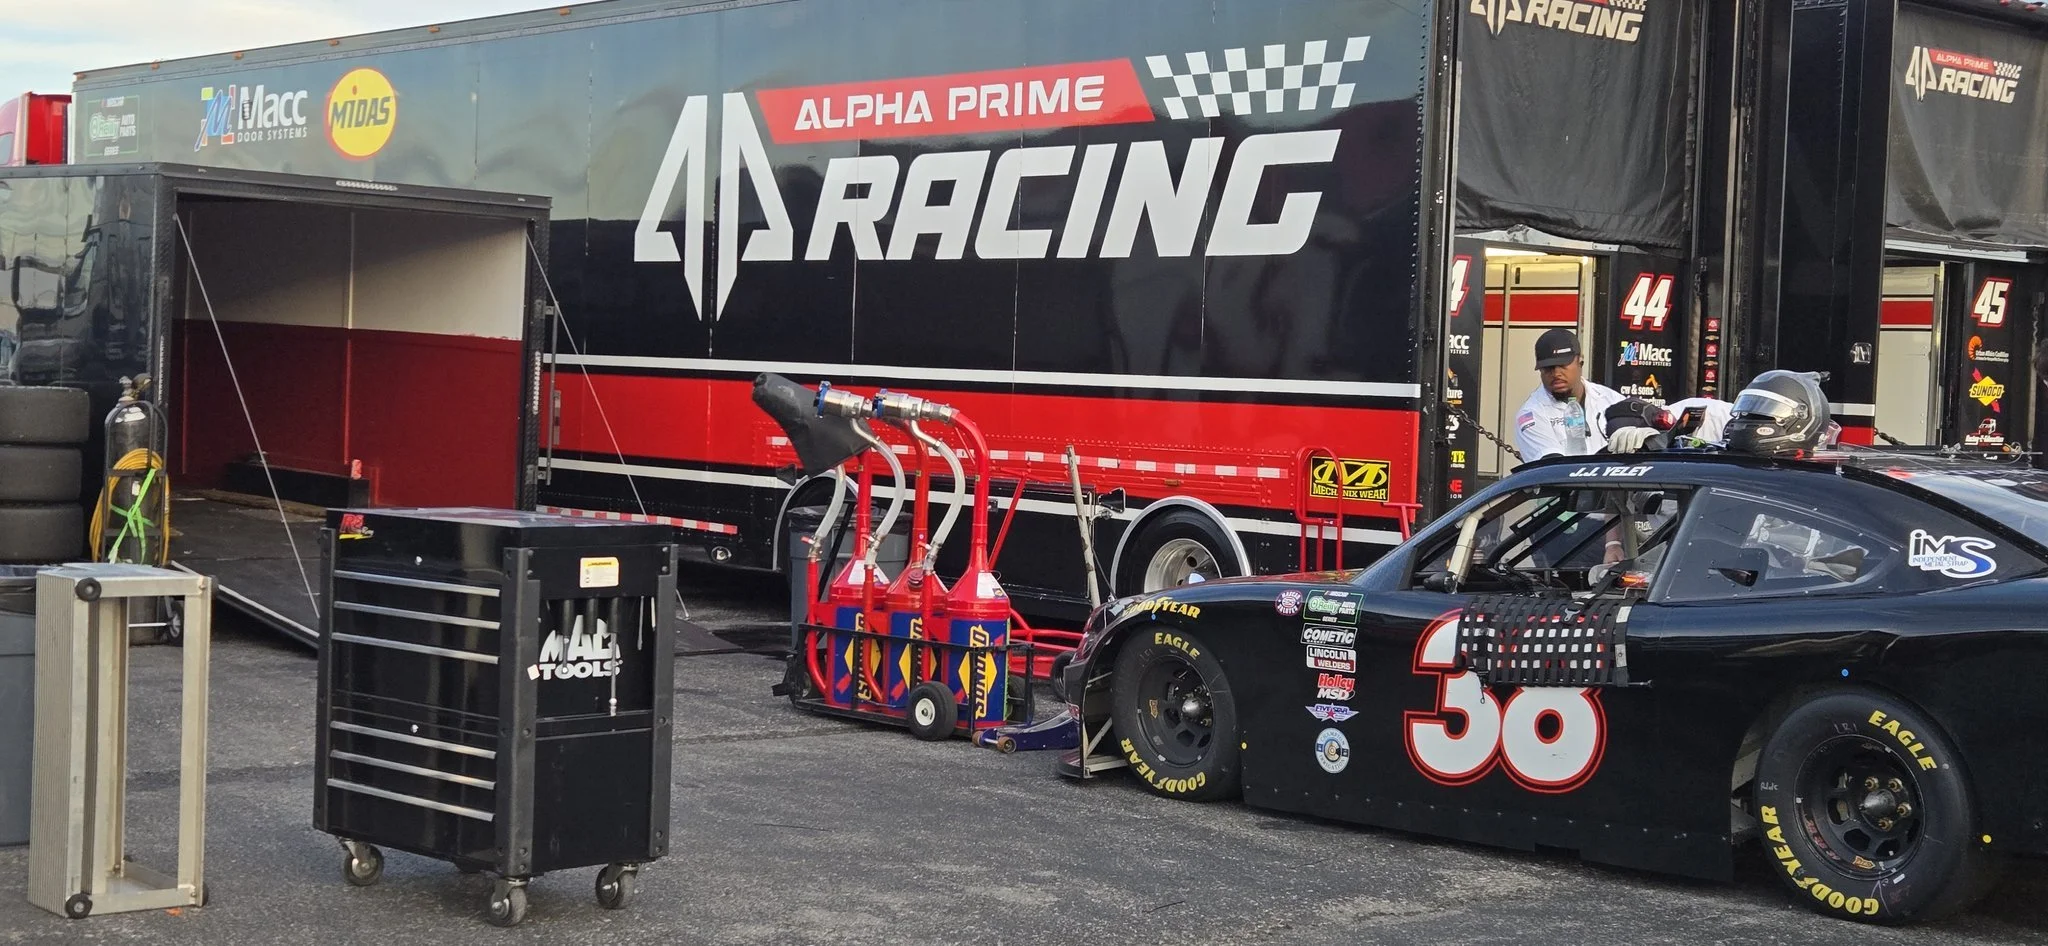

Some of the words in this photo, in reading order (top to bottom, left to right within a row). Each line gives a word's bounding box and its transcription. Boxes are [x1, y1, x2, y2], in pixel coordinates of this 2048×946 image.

[1524, 0, 1644, 42] RACING
[1936, 53, 1962, 67] ALPHA
[1964, 58, 1990, 70] PRIME
[1938, 67, 2018, 104] RACING
[238, 85, 308, 129] Macc
[331, 96, 391, 129] MIDAS
[794, 90, 933, 131] ALPHA
[948, 75, 1105, 121] PRIME
[237, 130, 263, 143] DOOR
[267, 127, 308, 140] SYSTEMS
[804, 129, 1342, 260] RACING
[1450, 256, 1471, 315] 4
[1621, 273, 1674, 330] 44
[1972, 278, 2012, 327] 45
[1449, 334, 1470, 350] acc
[1639, 343, 1672, 362] Macc
[1631, 384, 1637, 395] &
[1638, 386, 1654, 396] sons
[1971, 385, 2002, 397] SUNOCO
[1569, 467, 1600, 477] J.J.
[1602, 466, 1654, 476] YELEY
[1312, 483, 1358, 498] MECHNIX
[1359, 488, 1388, 500] WEAR
[1912, 555, 1957, 563] INDEPENDENT
[1122, 596, 1201, 619] GOODYEAR
[1154, 632, 1200, 661] EAGLE
[1303, 628, 1355, 645] COMETIC
[1309, 647, 1347, 661] LINCOLN
[538, 661, 621, 681] TOOLS
[1318, 659, 1351, 671] WELDERS
[1318, 673, 1355, 692] Holley
[1317, 688, 1350, 700] MSD
[1404, 608, 1608, 794] 38
[1333, 706, 1349, 714] STAR
[1868, 710, 1938, 771] EAGLE
[1120, 737, 1206, 793] GOODYEAR
[1760, 805, 1880, 915] GOODYEAR
